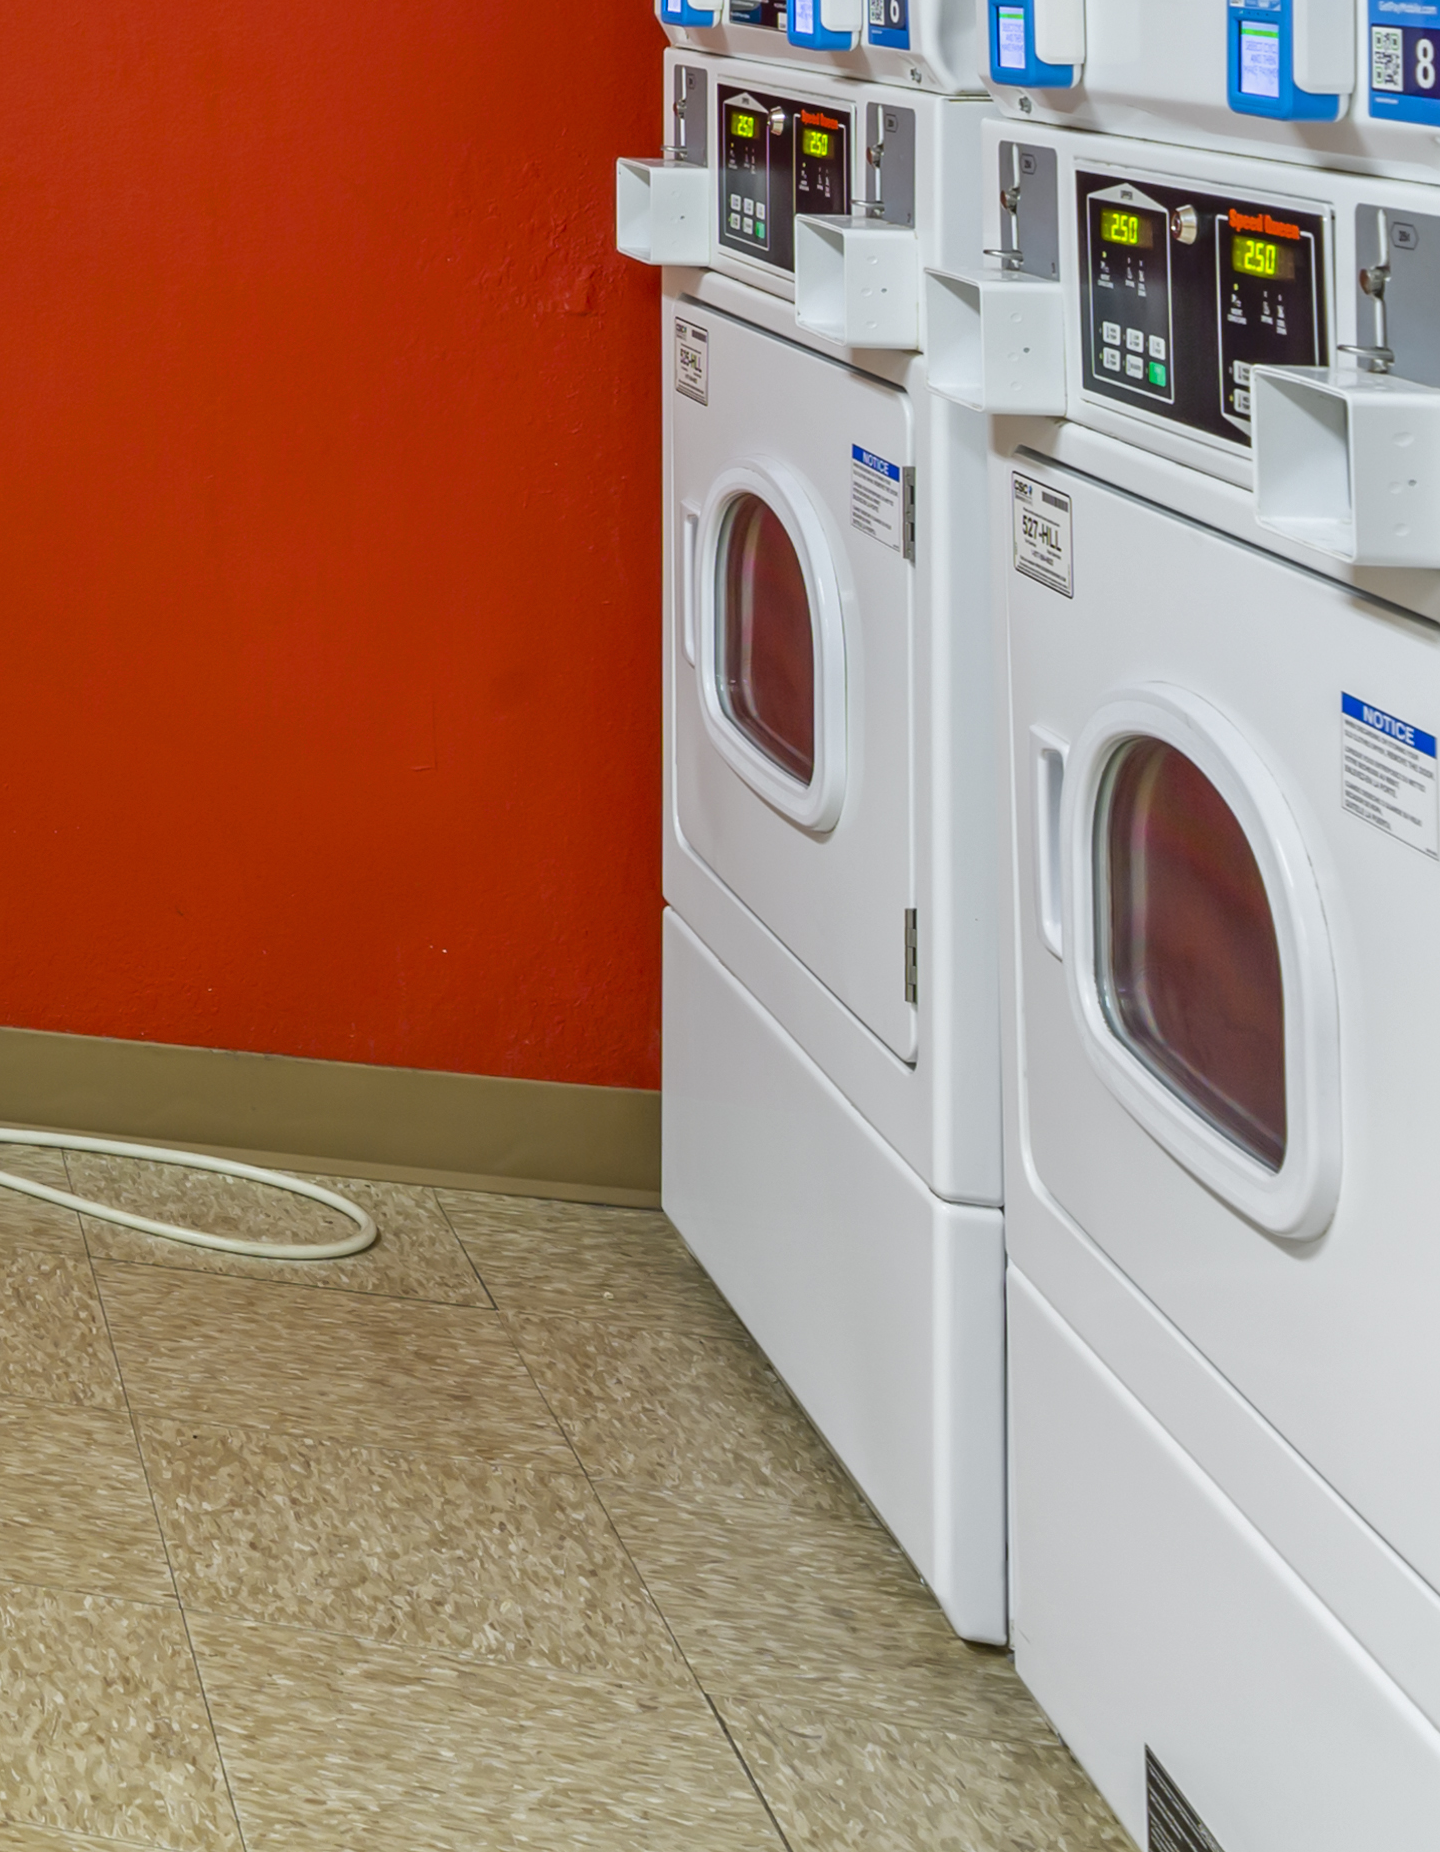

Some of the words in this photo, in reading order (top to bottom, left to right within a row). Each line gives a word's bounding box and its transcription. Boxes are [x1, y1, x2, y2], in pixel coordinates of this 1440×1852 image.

[1415, 38, 1436, 89] 8
[1229, 208, 1264, 232] Speed
[1264, 214, 1301, 240] Queen
[862, 451, 889, 476] NOTICE
[1022, 514, 1062, 552] 527-HLL
[1362, 705, 1416, 747] NOTICE
